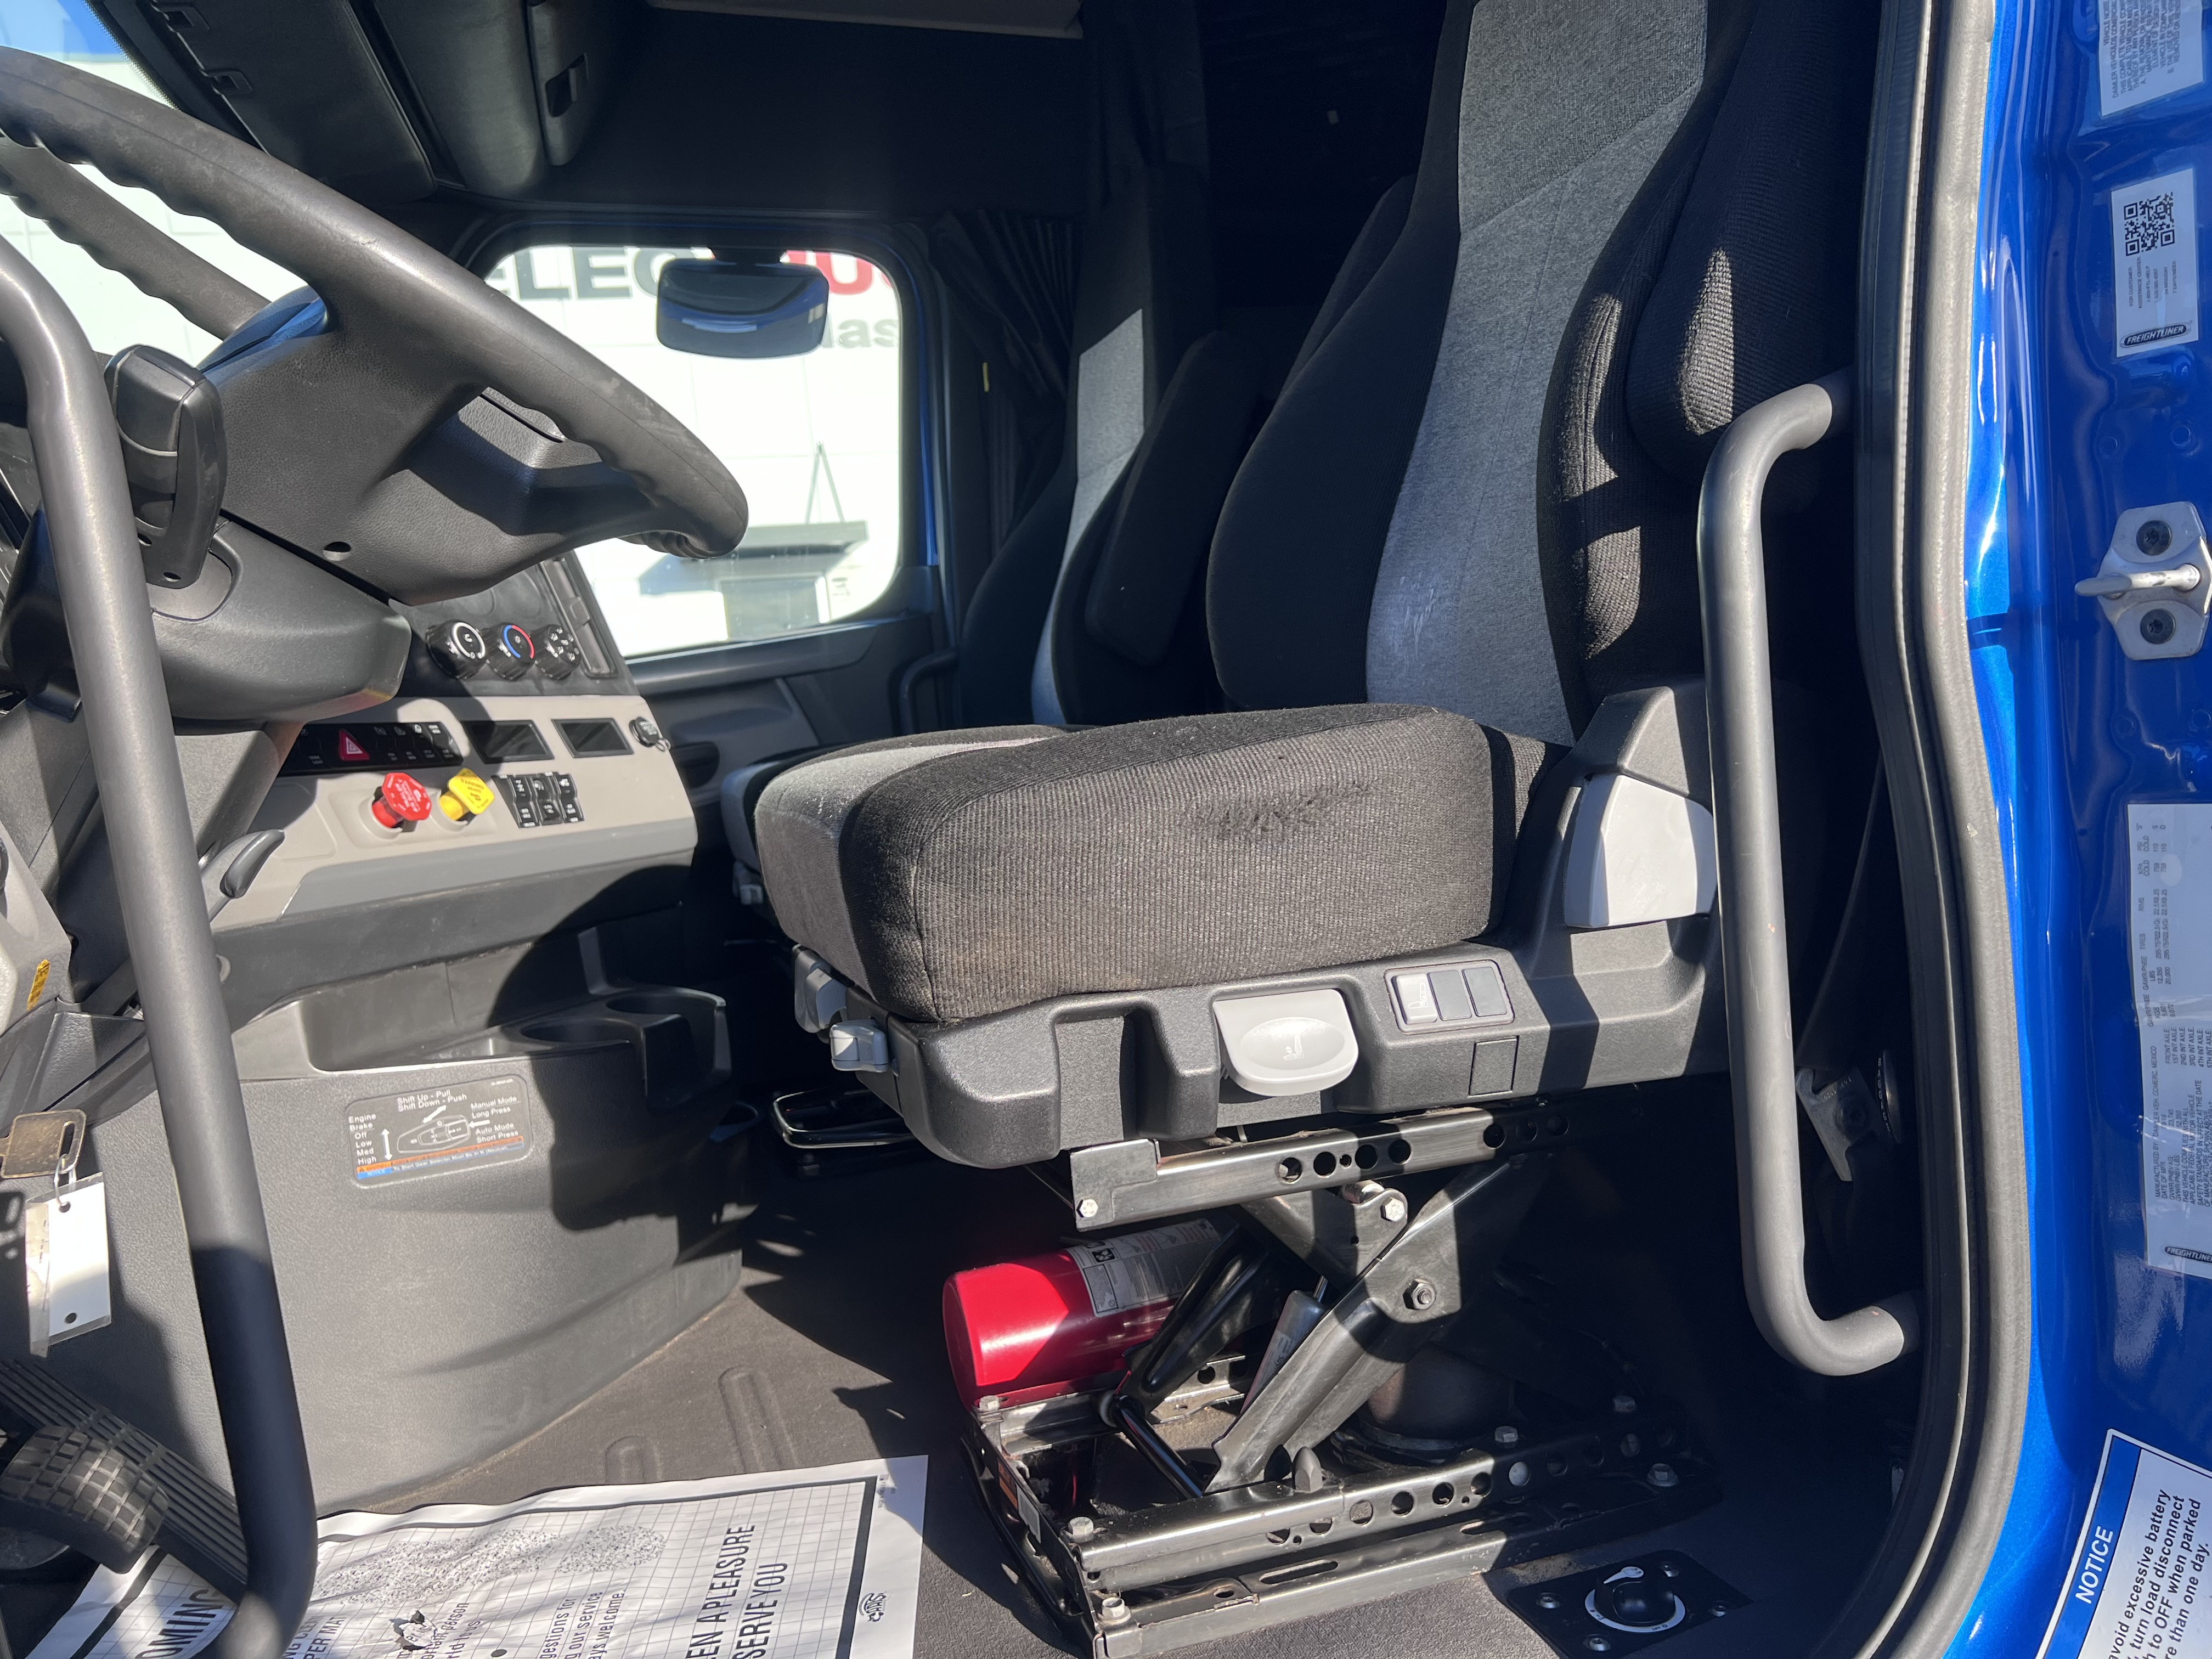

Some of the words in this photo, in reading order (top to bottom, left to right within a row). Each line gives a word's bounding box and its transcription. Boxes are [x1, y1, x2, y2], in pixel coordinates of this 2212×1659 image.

[2126, 326, 2185, 345] FREIGHTLINER
[397, 1095, 415, 1105] Shift
[436, 1089, 450, 1098] Pull
[398, 1102, 416, 1112] Shift
[418, 1099, 440, 1108] Down
[448, 1093, 467, 1103] Push
[471, 1099, 496, 1110] Manual
[498, 1096, 517, 1105] Mode
[348, 1114, 376, 1124] Engine
[472, 1110, 489, 1119] Long
[491, 1106, 511, 1115] Press
[349, 1122, 373, 1131] Brake
[354, 1131, 368, 1139] Off
[476, 1126, 493, 1135] Auto
[494, 1122, 514, 1132] Mode
[356, 1140, 373, 1148] Low
[476, 1134, 496, 1143] Short
[498, 1130, 518, 1139] Press
[357, 1147, 374, 1157] Med
[358, 1155, 377, 1165] High
[2161, 1175, 2166, 1183] OF
[2204, 1199, 2210, 1207] OF
[2180, 1498, 2201, 1552] parked
[2075, 1526, 2113, 1603] NOTICE
[2190, 1543, 2210, 1572] day.
[701, 1524, 755, 1611] PLEASURE
[2108, 1622, 2130, 1659] avoid
[2123, 1546, 2154, 1619] excessive
[2145, 1489, 2171, 1543] battery
[2129, 1619, 2149, 1650] turn
[2140, 1581, 2161, 1615] load
[2153, 1496, 2184, 1578] disconnect
[2167, 1555, 2187, 1594] when
[749, 1562, 788, 1599] YOU
[2182, 1576, 2199, 1604] one
[441, 1602, 470, 1629] person
[576, 1592, 603, 1628] service
[696, 1611, 730, 1623] A
[2154, 1595, 2172, 1629] OFF
[317, 1616, 347, 1634] MAT
[464, 1621, 481, 1631] us
[539, 1612, 570, 1659] gestions
[556, 1599, 577, 1610] for
[731, 1599, 779, 1659] SERVE
[2168, 1608, 2190, 1643] than
[568, 1631, 586, 1650] our
[685, 1630, 724, 1659] EN
[2147, 1634, 2162, 1649] to
